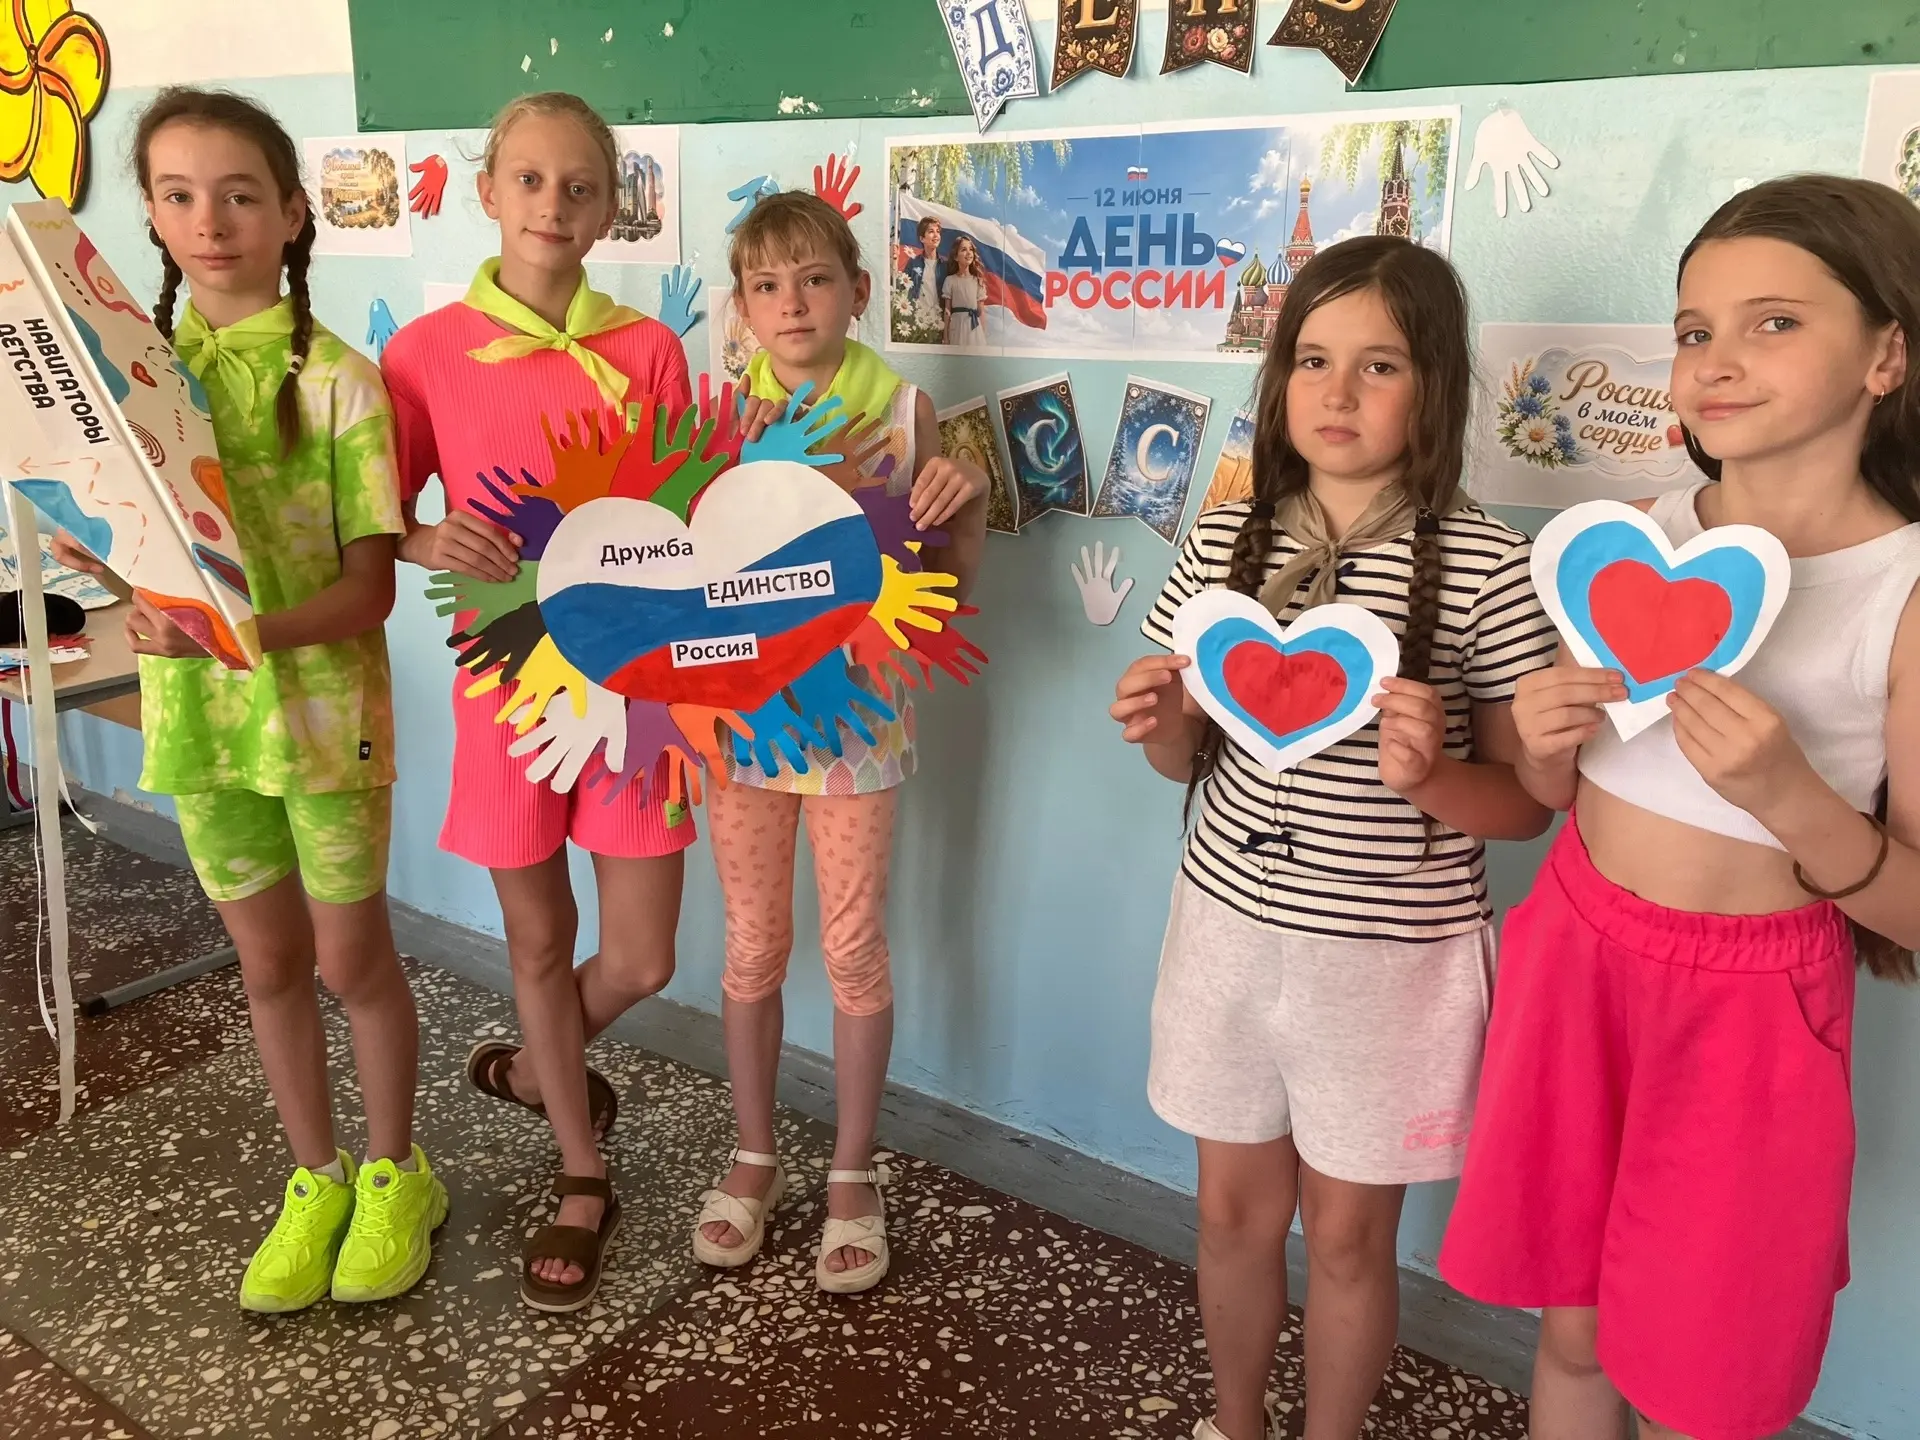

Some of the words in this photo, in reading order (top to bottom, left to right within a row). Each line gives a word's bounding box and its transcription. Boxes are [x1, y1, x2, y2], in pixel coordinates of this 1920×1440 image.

[1093, 188, 1116, 207] 12
[1121, 188, 1182, 207] ИЮНЯ
[1058, 213, 1215, 275] ДЕНЬ
[1045, 269, 1226, 310] РОССИИ
[0, 324, 56, 409] ДЕТСТВА
[23, 318, 110, 444] НАВИГАТОРЫ
[1577, 401, 1592, 418] в
[1594, 409, 1658, 429] моём
[1579, 424, 1663, 455] сердце
[600, 538, 694, 567] Дружба
[707, 569, 831, 603] ЕДИНСТВО
[676, 641, 754, 661] Россия
